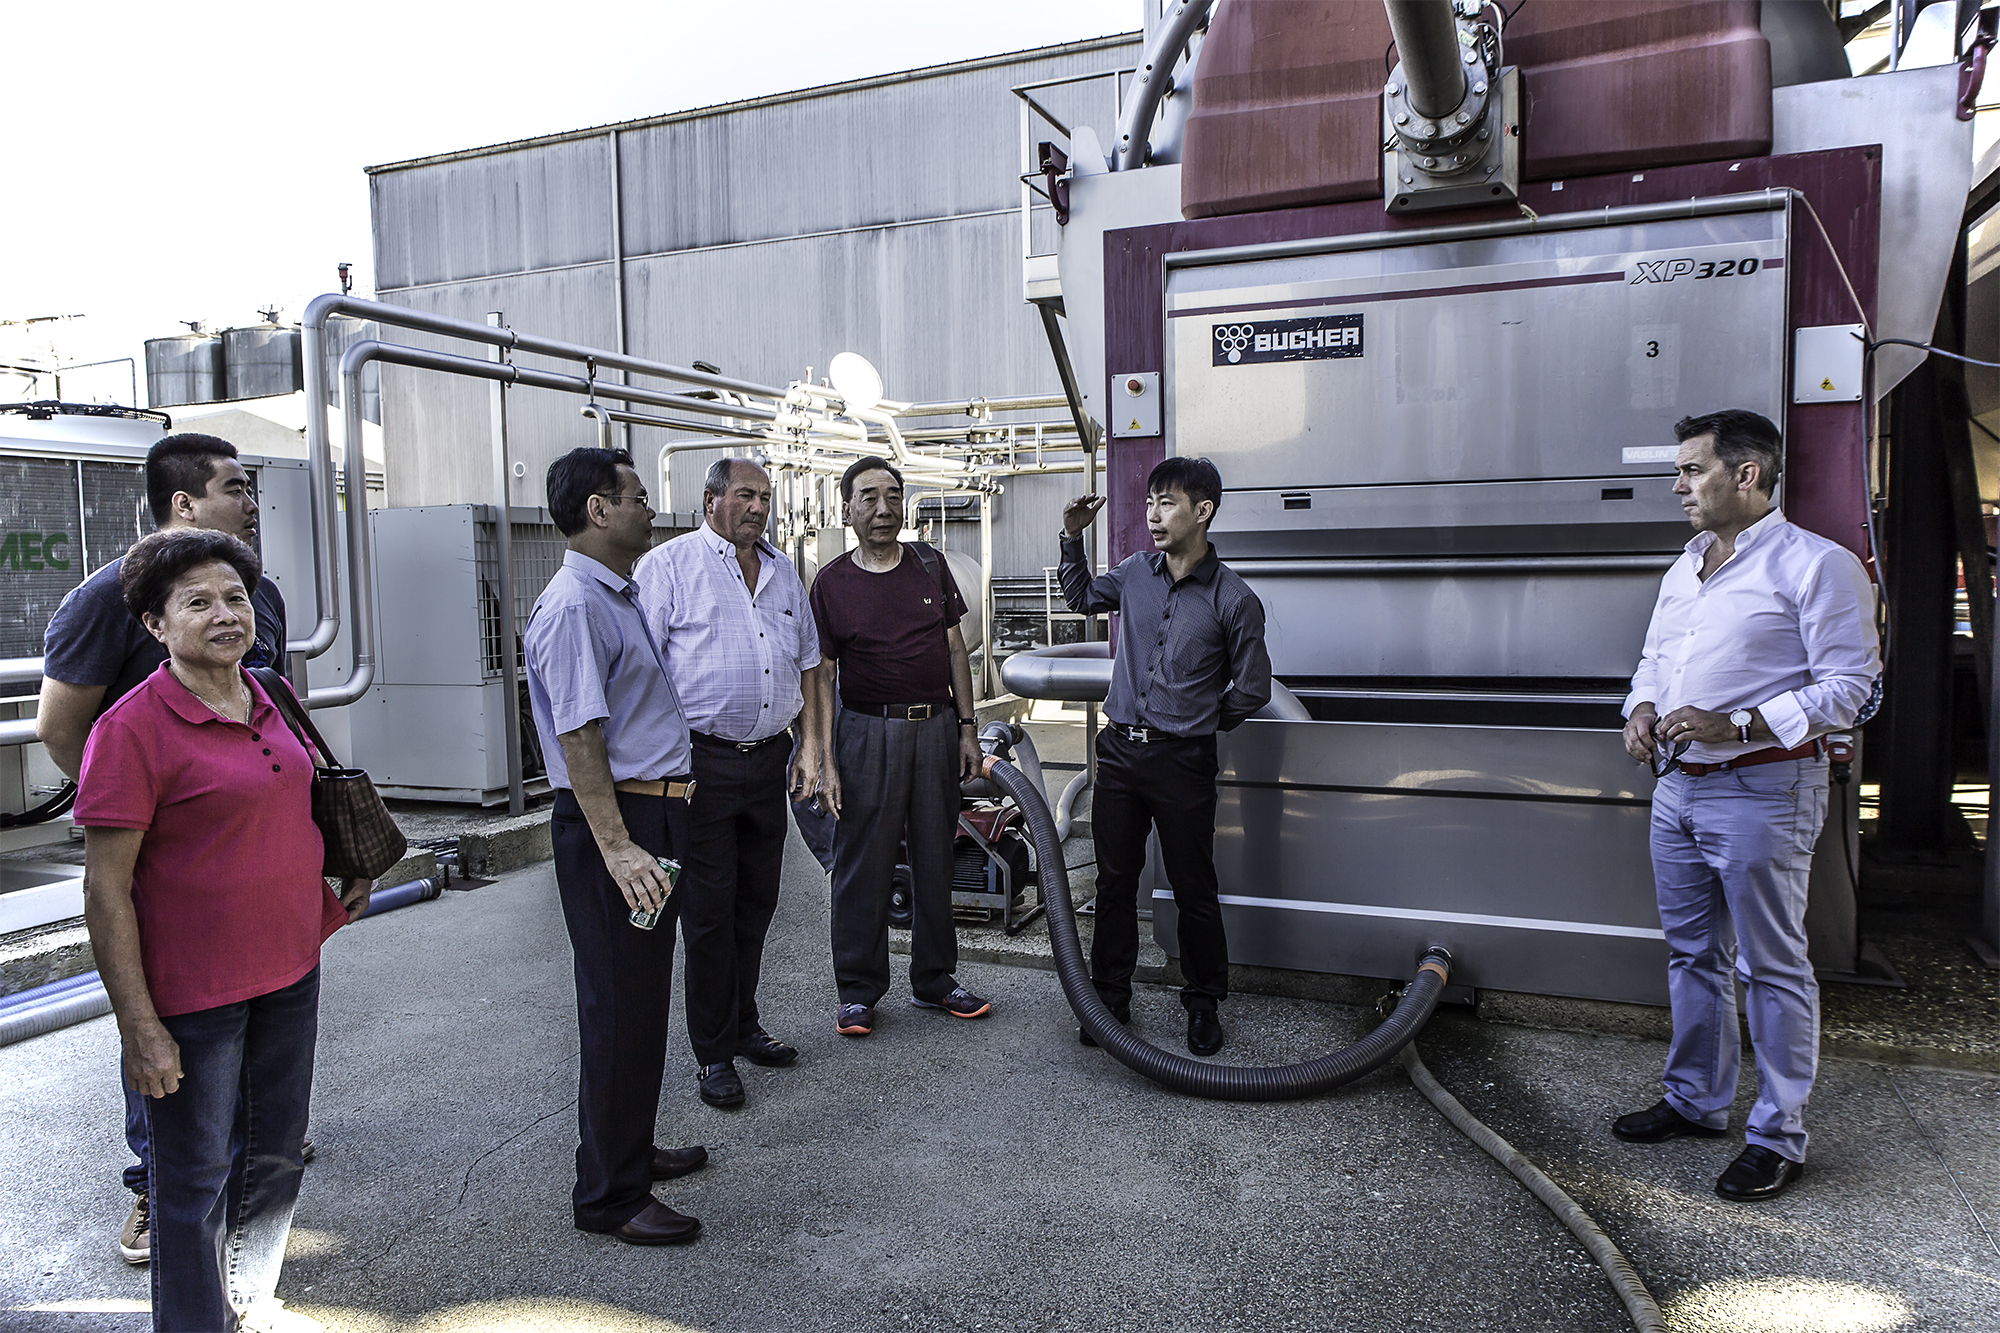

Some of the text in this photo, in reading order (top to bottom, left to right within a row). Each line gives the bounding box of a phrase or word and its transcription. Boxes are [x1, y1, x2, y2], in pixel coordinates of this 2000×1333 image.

[1254, 327, 1360, 352] BUCHER
[1646, 340, 1659, 358] 3
[1625, 449, 1669, 460] VASLIN
